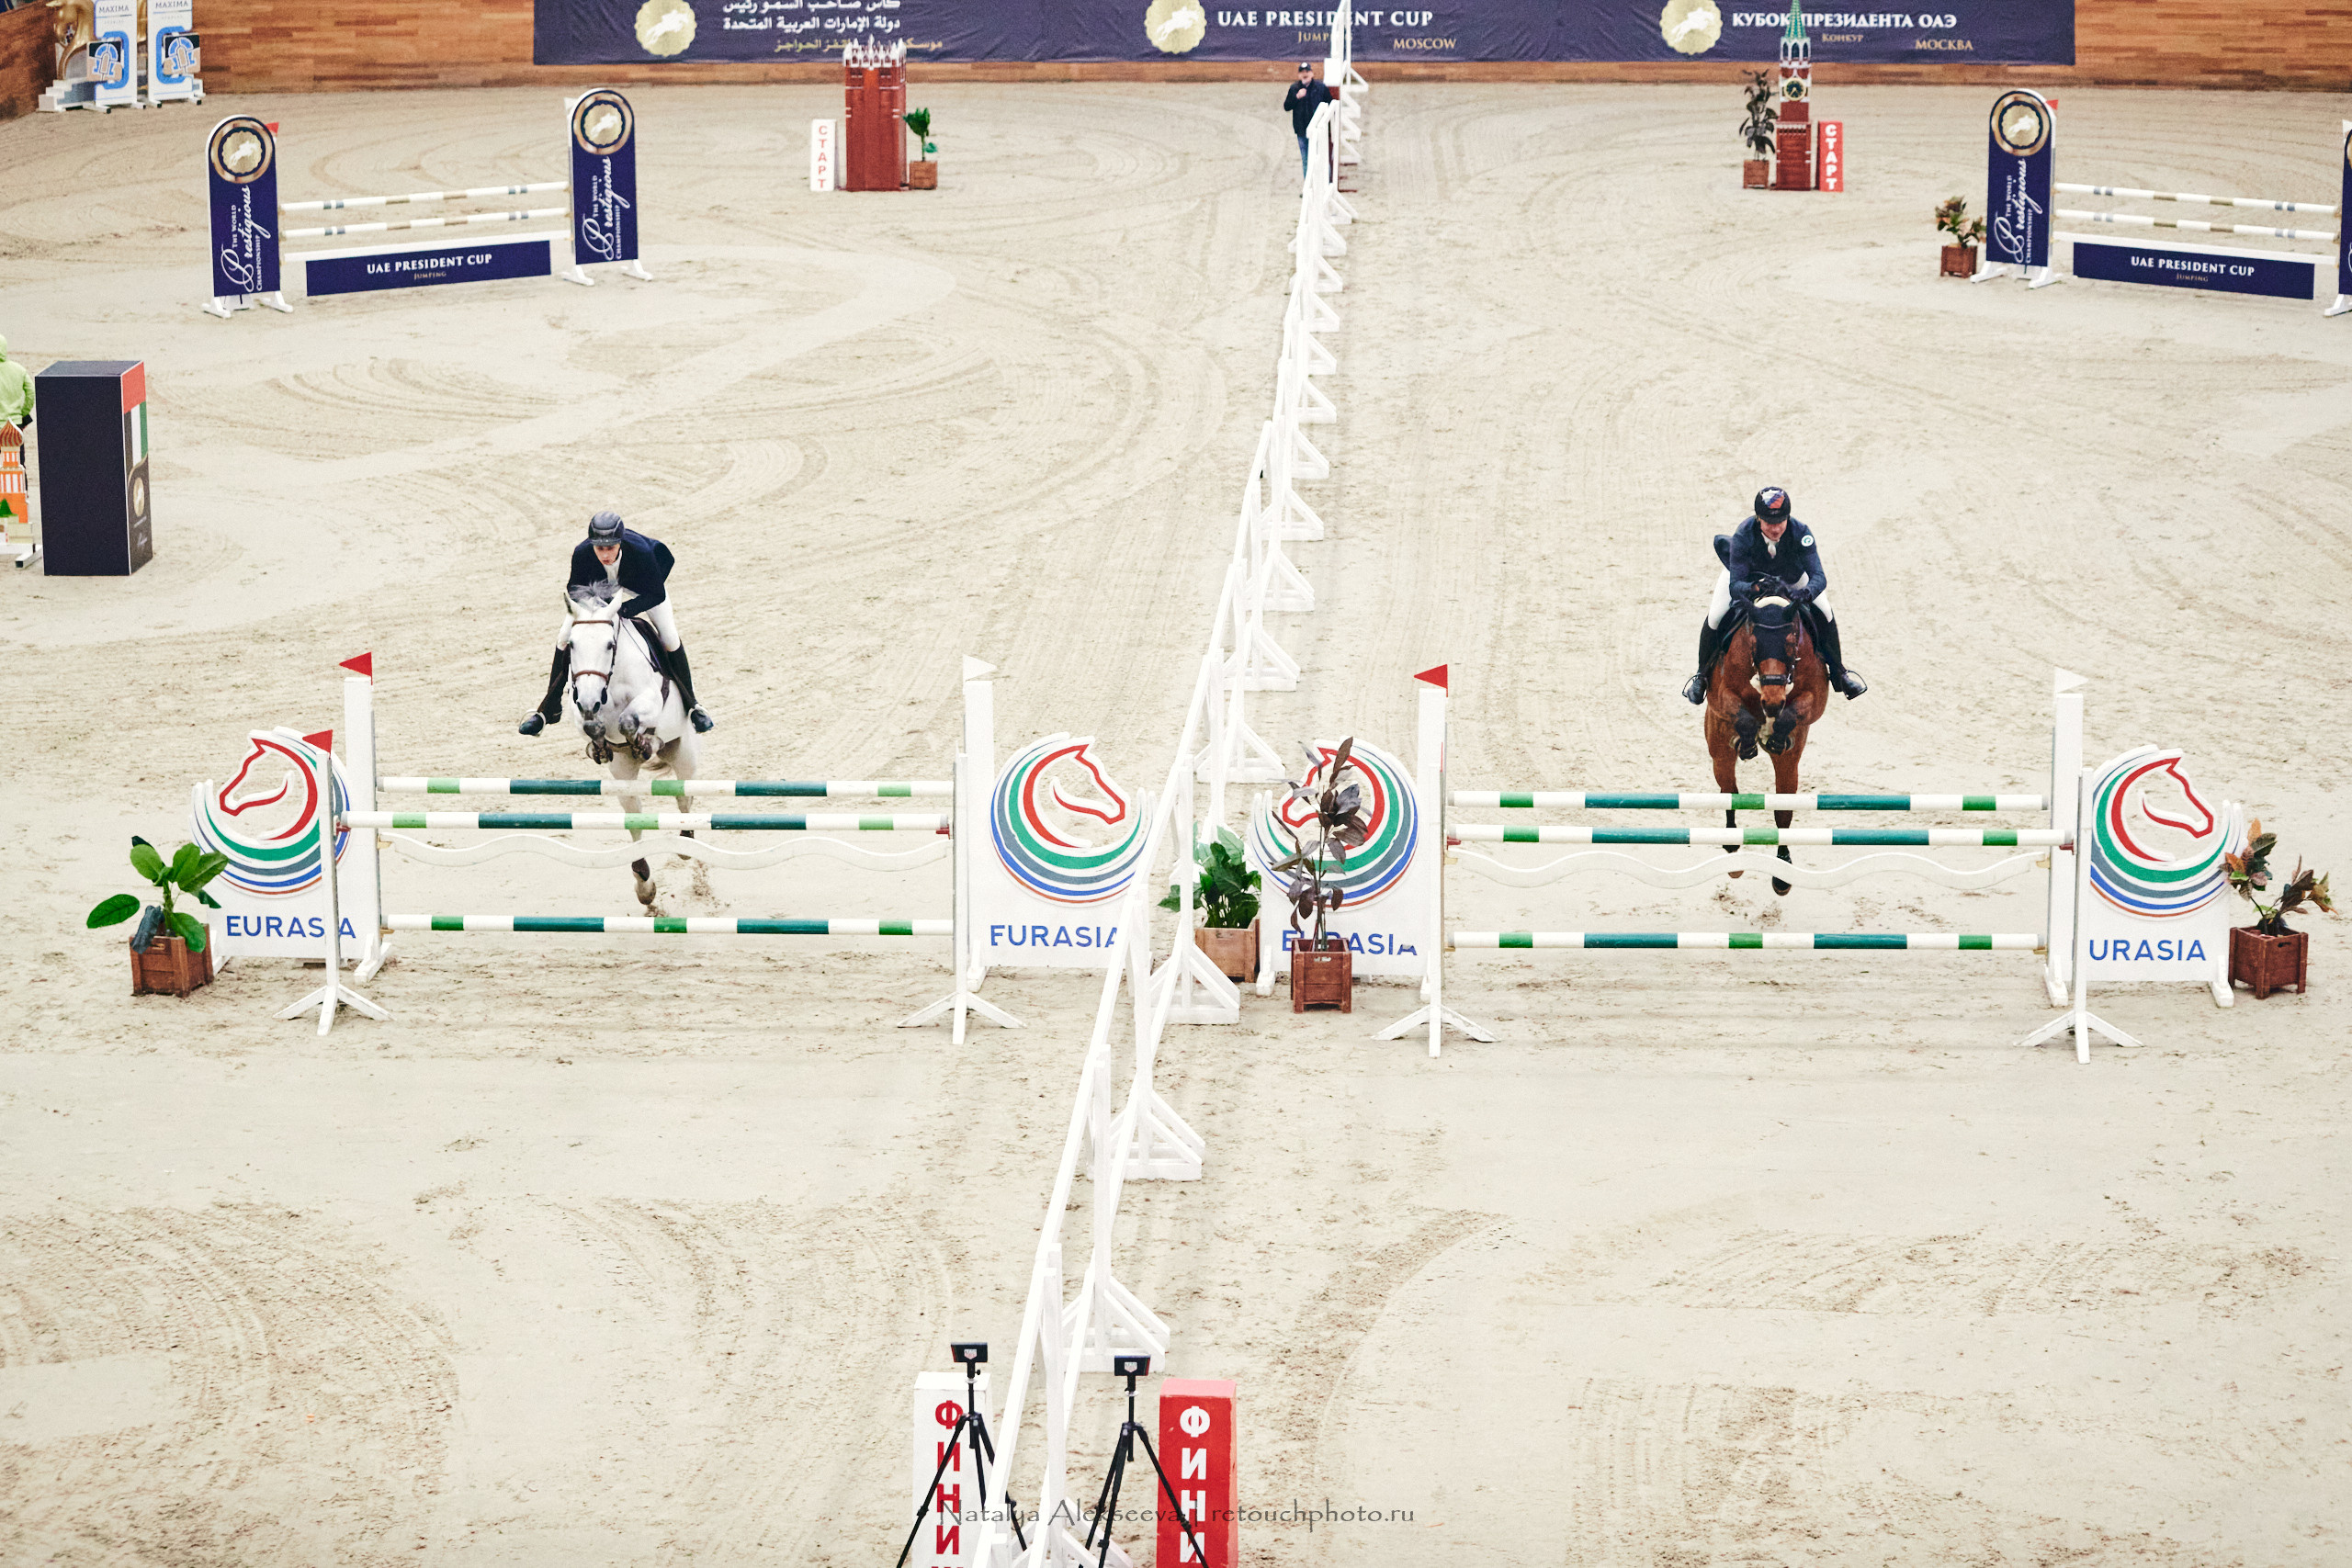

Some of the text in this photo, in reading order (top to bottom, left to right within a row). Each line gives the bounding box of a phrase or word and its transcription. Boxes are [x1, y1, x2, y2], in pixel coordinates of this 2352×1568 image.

[98, 5, 130, 13] MAXIMA
[723, 16, 900, 34] دولة الإمارات العربية المتحدة
[1217, 11, 1433, 26] UAE PRESIDNT CUP
[1732, 13, 1957, 28] КУБОК ПРЕЗИДЕНТА ОАЭ
[1298, 31, 1352, 43] JUMP
[1393, 39, 1457, 50] MOSCOW
[1915, 39, 1973, 51] МОСКВА
[818, 125, 828, 188] СТАРТ
[1825, 124, 1838, 190] СТАРТ
[368, 254, 492, 274] UAE PRESIDENT CUP
[2131, 255, 2255, 276] UAE PRESIDENT CUP
[226, 915, 356, 939] EURASA
[932, 1400, 964, 1568] ФИНИ
